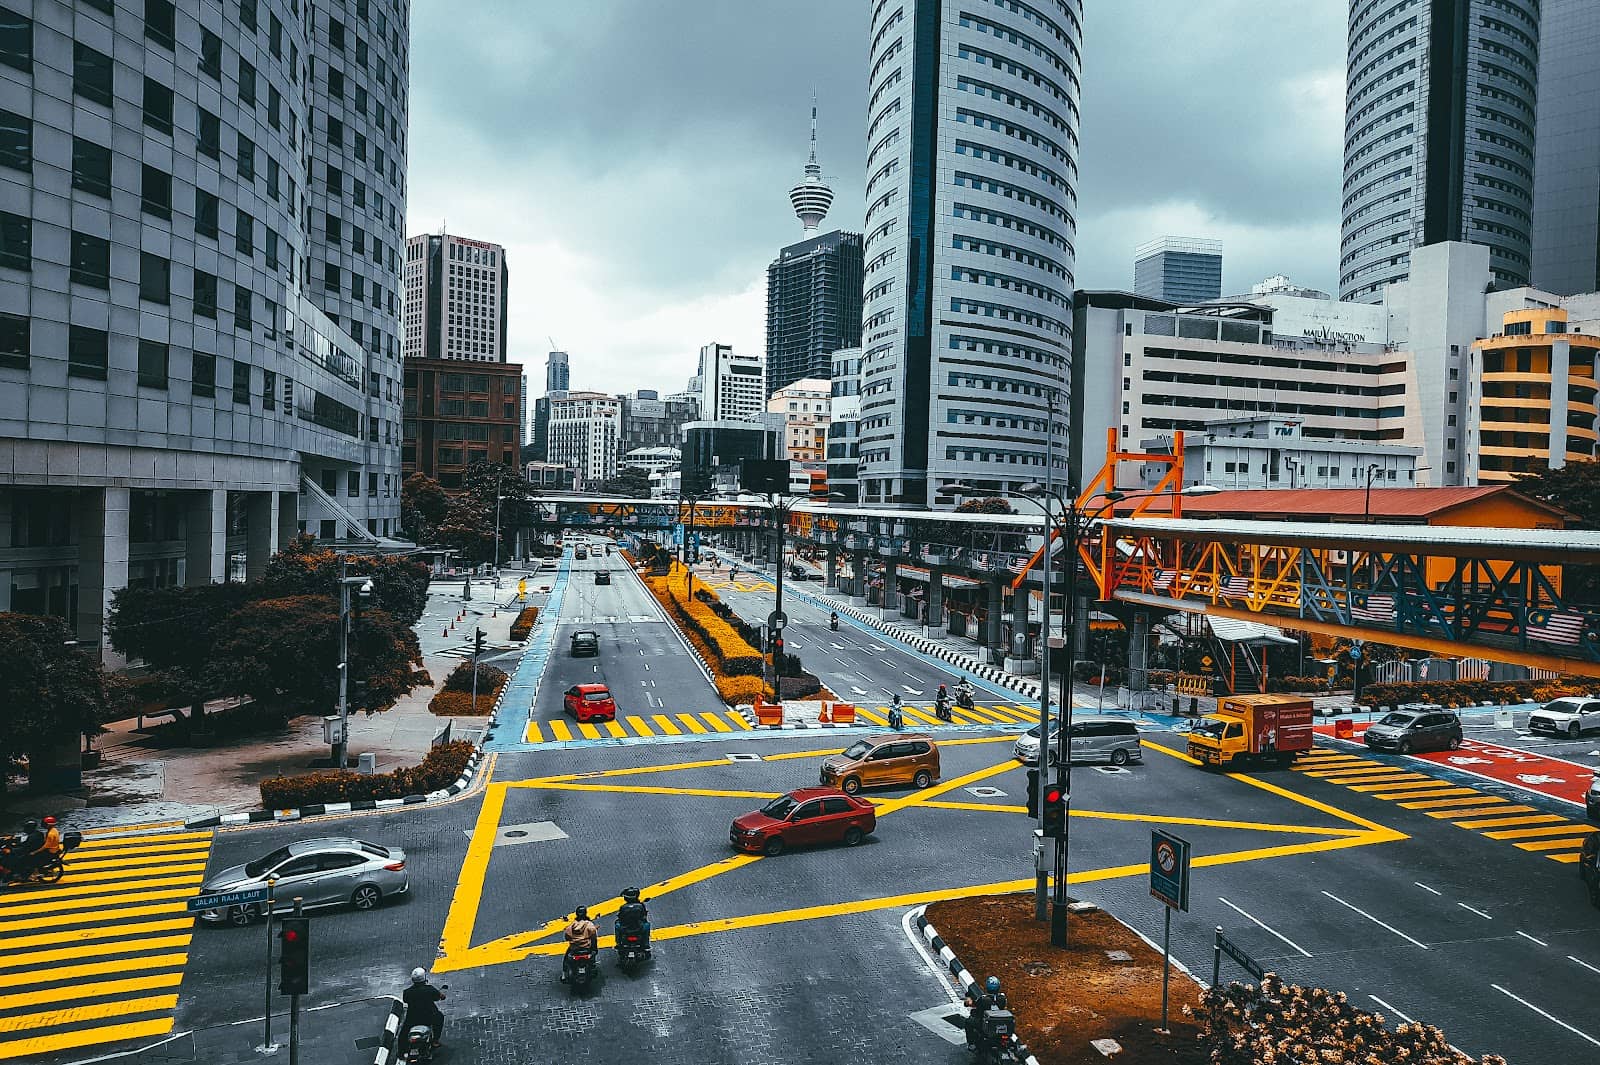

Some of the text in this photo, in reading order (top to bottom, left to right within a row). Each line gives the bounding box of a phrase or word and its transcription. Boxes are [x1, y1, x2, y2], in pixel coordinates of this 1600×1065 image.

[1274, 427, 1293, 436] TM
[195, 891, 261, 906] JALAN RAJA LAUT
